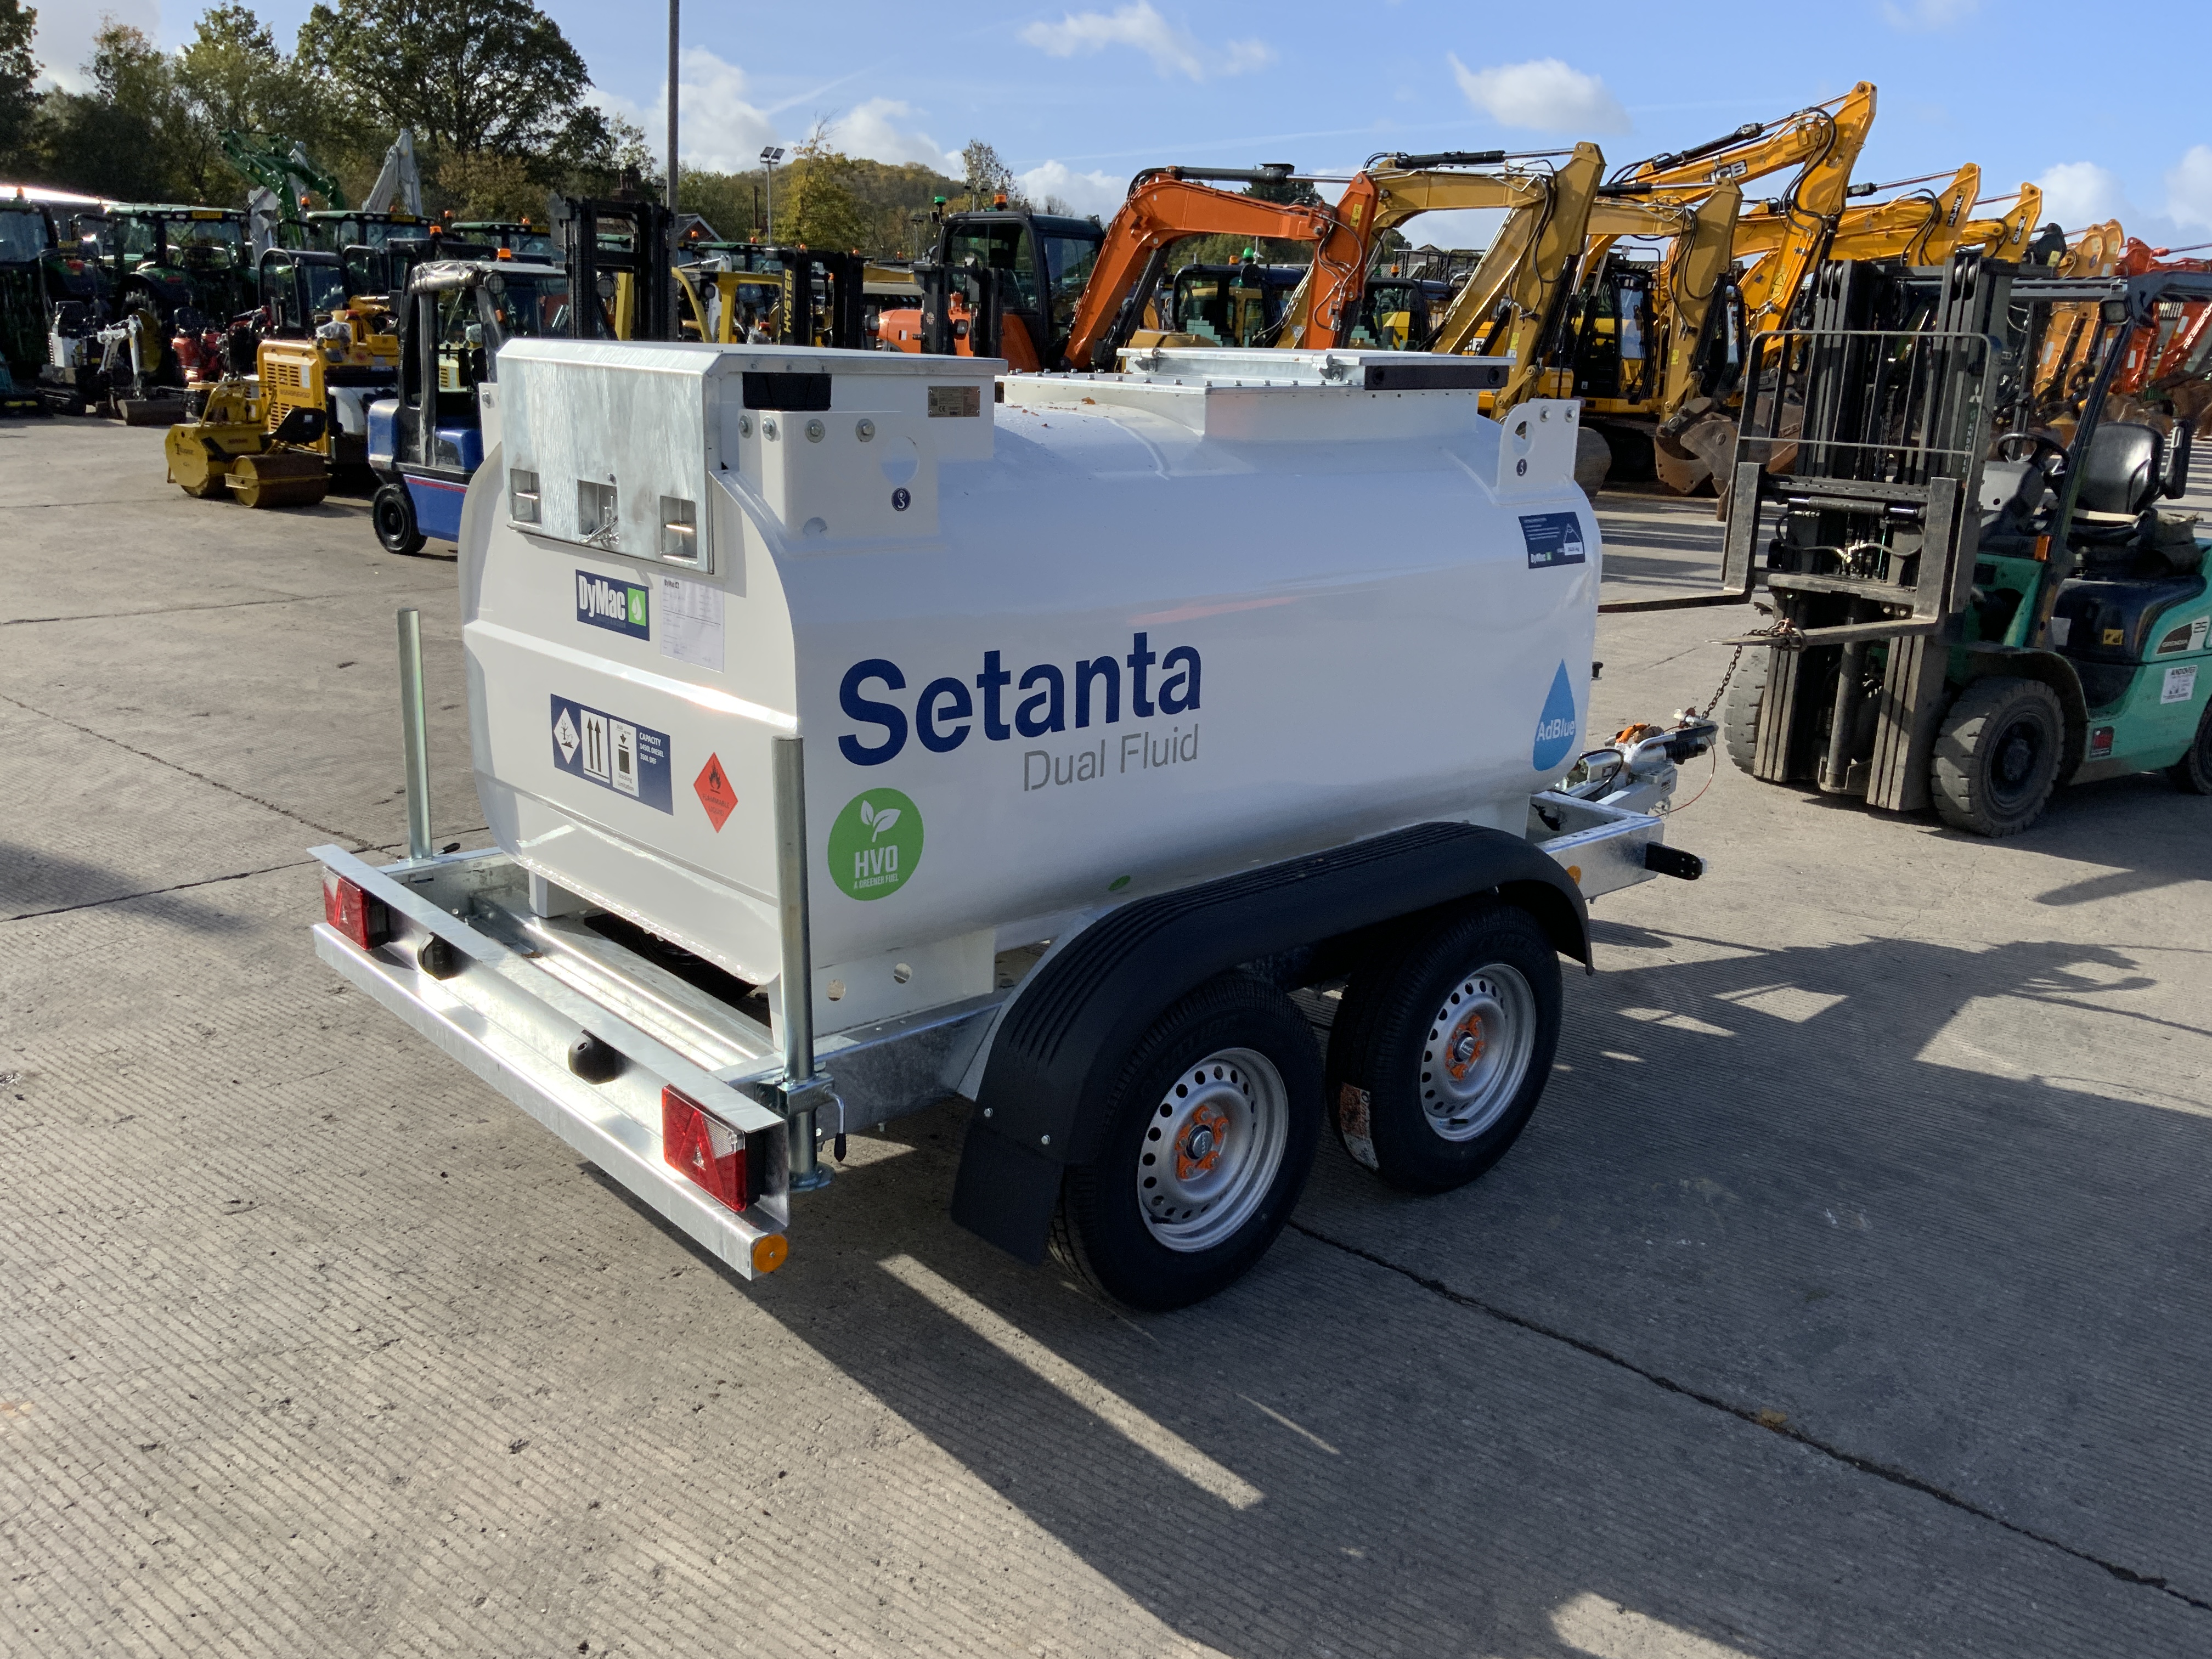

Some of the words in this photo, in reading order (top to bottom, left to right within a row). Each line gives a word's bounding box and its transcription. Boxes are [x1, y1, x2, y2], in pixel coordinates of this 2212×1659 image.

[1705, 160, 1747, 183] JCB
[783, 269, 793, 333] HYSTER
[578, 575, 625, 620] DyMac
[838, 631, 1202, 766] Setanta
[639, 732, 662, 747] CAPACITY
[1536, 718, 1575, 742] AdBlue
[651, 747, 664, 758] DIESEL
[1024, 739, 1105, 792] Dual
[1120, 723, 1200, 774] Fluid
[617, 780, 635, 792] Limitation
[618, 772, 633, 784] Stacking
[854, 845, 899, 878] HVO
[854, 880, 859, 890] A
[859, 876, 885, 889] GREENER
[885, 873, 899, 884] FUEL
